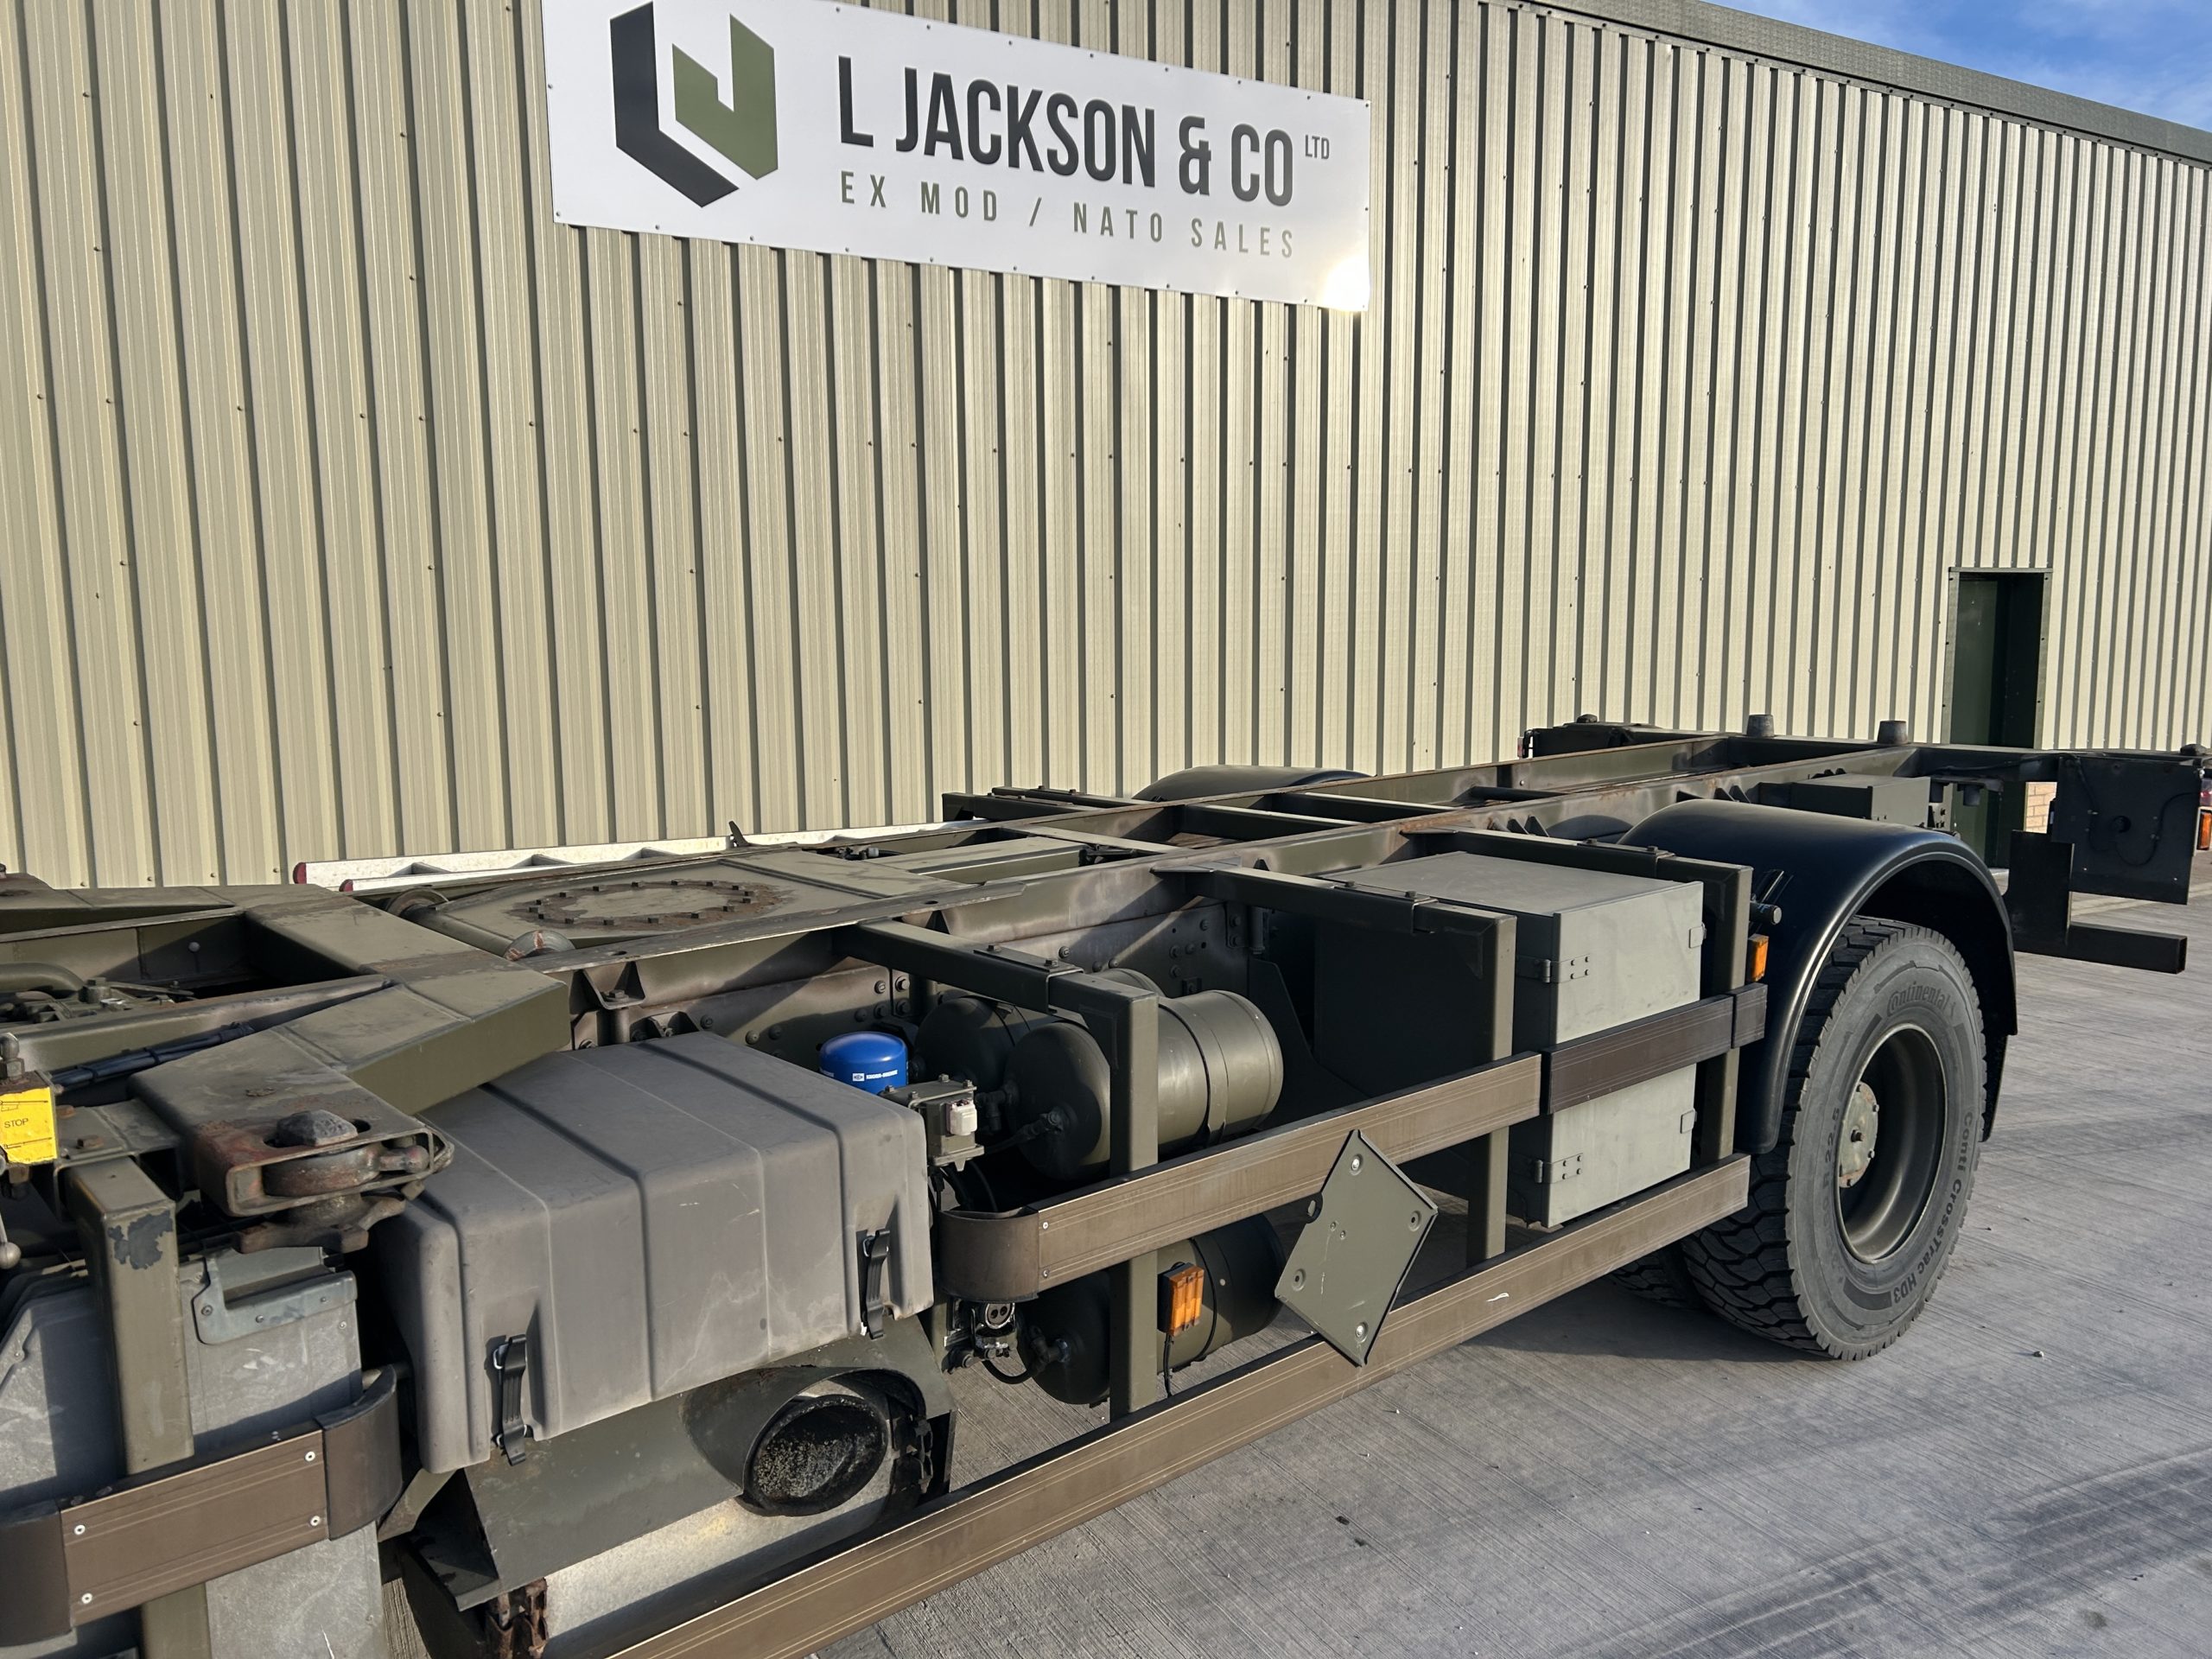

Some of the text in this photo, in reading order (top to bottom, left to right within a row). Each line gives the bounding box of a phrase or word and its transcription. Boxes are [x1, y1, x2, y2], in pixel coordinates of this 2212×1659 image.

[838, 55, 1330, 207] L JACKSON & CO LTD
[841, 170, 887, 208] EX
[920, 181, 997, 222] MOD
[1073, 201, 1163, 243] NATO
[1191, 217, 1294, 259] SALES
[1886, 980, 1951, 1018] Continental
[4, 1117, 29, 1128] STOP
[1893, 1111, 1974, 1304] Conti CrossTrac HD3
